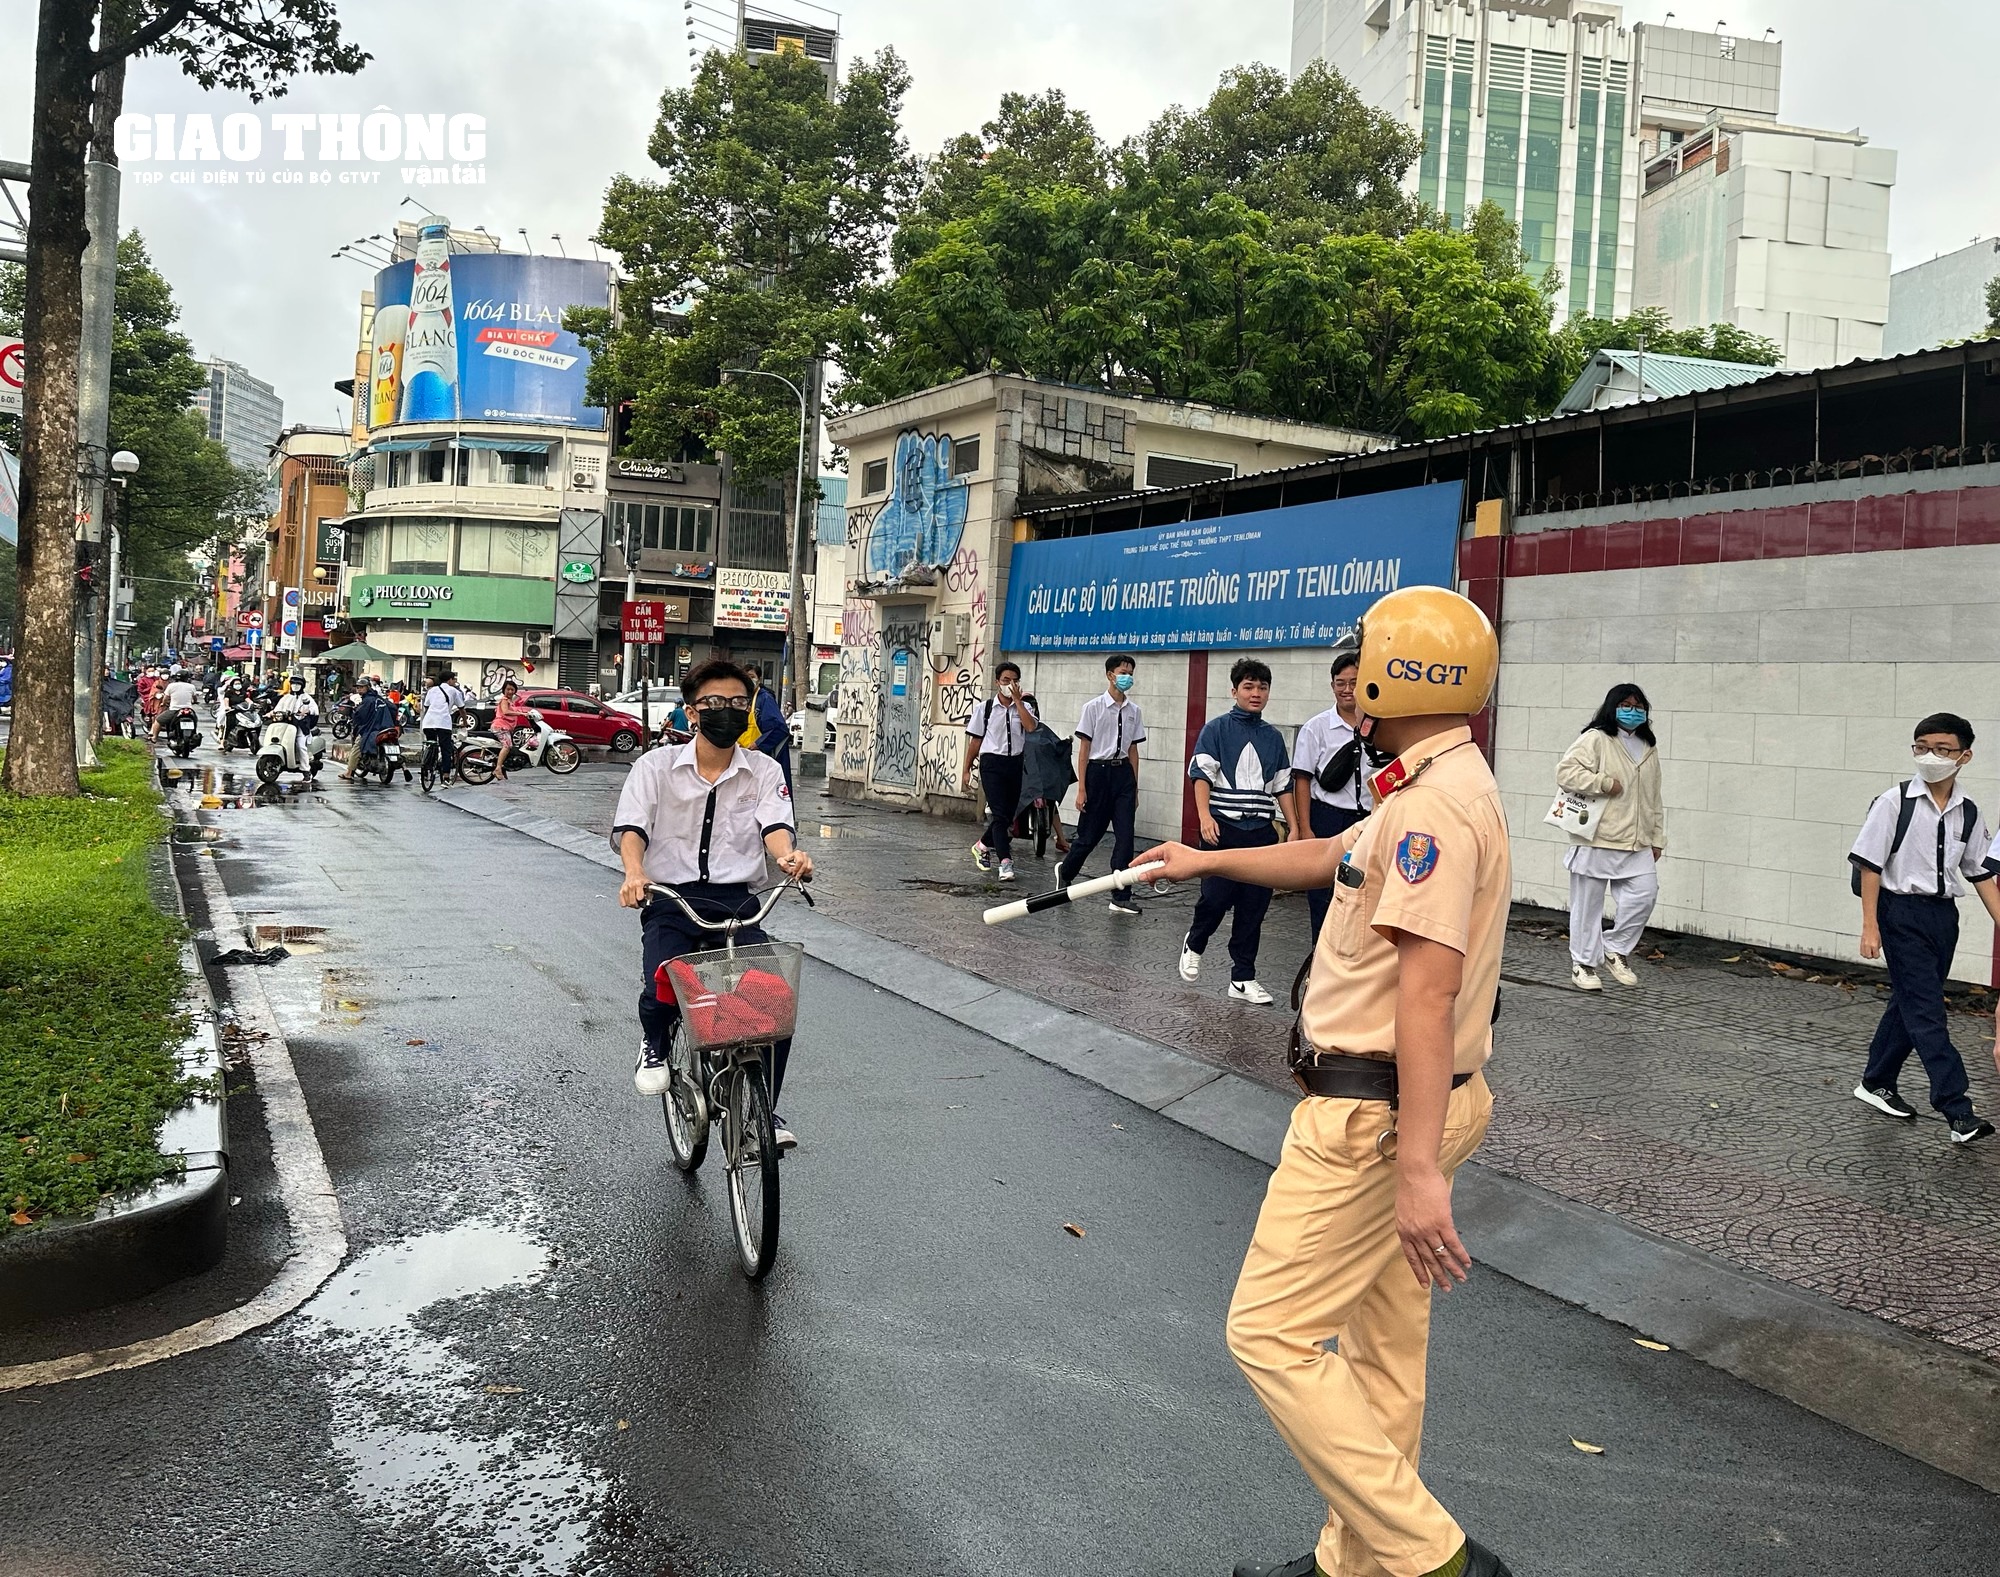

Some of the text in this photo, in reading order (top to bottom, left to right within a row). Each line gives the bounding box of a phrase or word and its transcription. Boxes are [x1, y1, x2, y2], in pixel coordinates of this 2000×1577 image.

[413, 279, 449, 306] 1664
[463, 299, 572, 324] 1664 BLAN
[405, 328, 455, 351] BLANC
[487, 331, 503, 339] BIA
[495, 346, 509, 355] GU
[1177, 529, 1190, 537] NHÂN
[1203, 525, 1216, 535] QUẬN
[325, 538, 341, 547] SUSH
[1123, 546, 1137, 554] TRUNG
[1139, 544, 1149, 552] TÂM
[1198, 536, 1217, 545] TRƯỜNG
[1219, 535, 1232, 543] THPT
[683, 564, 706, 576] Tiger
[719, 570, 778, 589] PHƯƠNG
[375, 585, 453, 600] PHUC LONG
[720, 588, 763, 597] PHOTOCOPY
[1028, 558, 1401, 618] CÂU LẠC BỘ VÕ KARATE TRƯỜNG THPT TENLƠMAN
[635, 603, 652, 616] CẤM
[630, 618, 641, 630] TỤ
[624, 629, 662, 641] BUÔN BÁN
[1041, 634, 1052, 647] gian
[1063, 634, 1077, 647] luyện
[1079, 633, 1088, 645] vào
[1089, 633, 1099, 645] các
[1101, 631, 1116, 645] chiều
[1117, 630, 1128, 644] thứ
[1129, 630, 1140, 646] bảy
[1141, 631, 1148, 644] và
[1150, 631, 1165, 645] sáng
[1168, 629, 1179, 643] chủ
[1181, 630, 1196, 645] nhật
[1197, 628, 1214, 644] hàng
[1216, 627, 1231, 641] tuần
[1240, 627, 1252, 641] Nơi
[1254, 627, 1272, 642] đăng
[1275, 626, 1287, 643] ký:
[1290, 622, 1301, 639] Tổ
[1302, 621, 1317, 639] thể
[1318, 624, 1333, 641] dục
